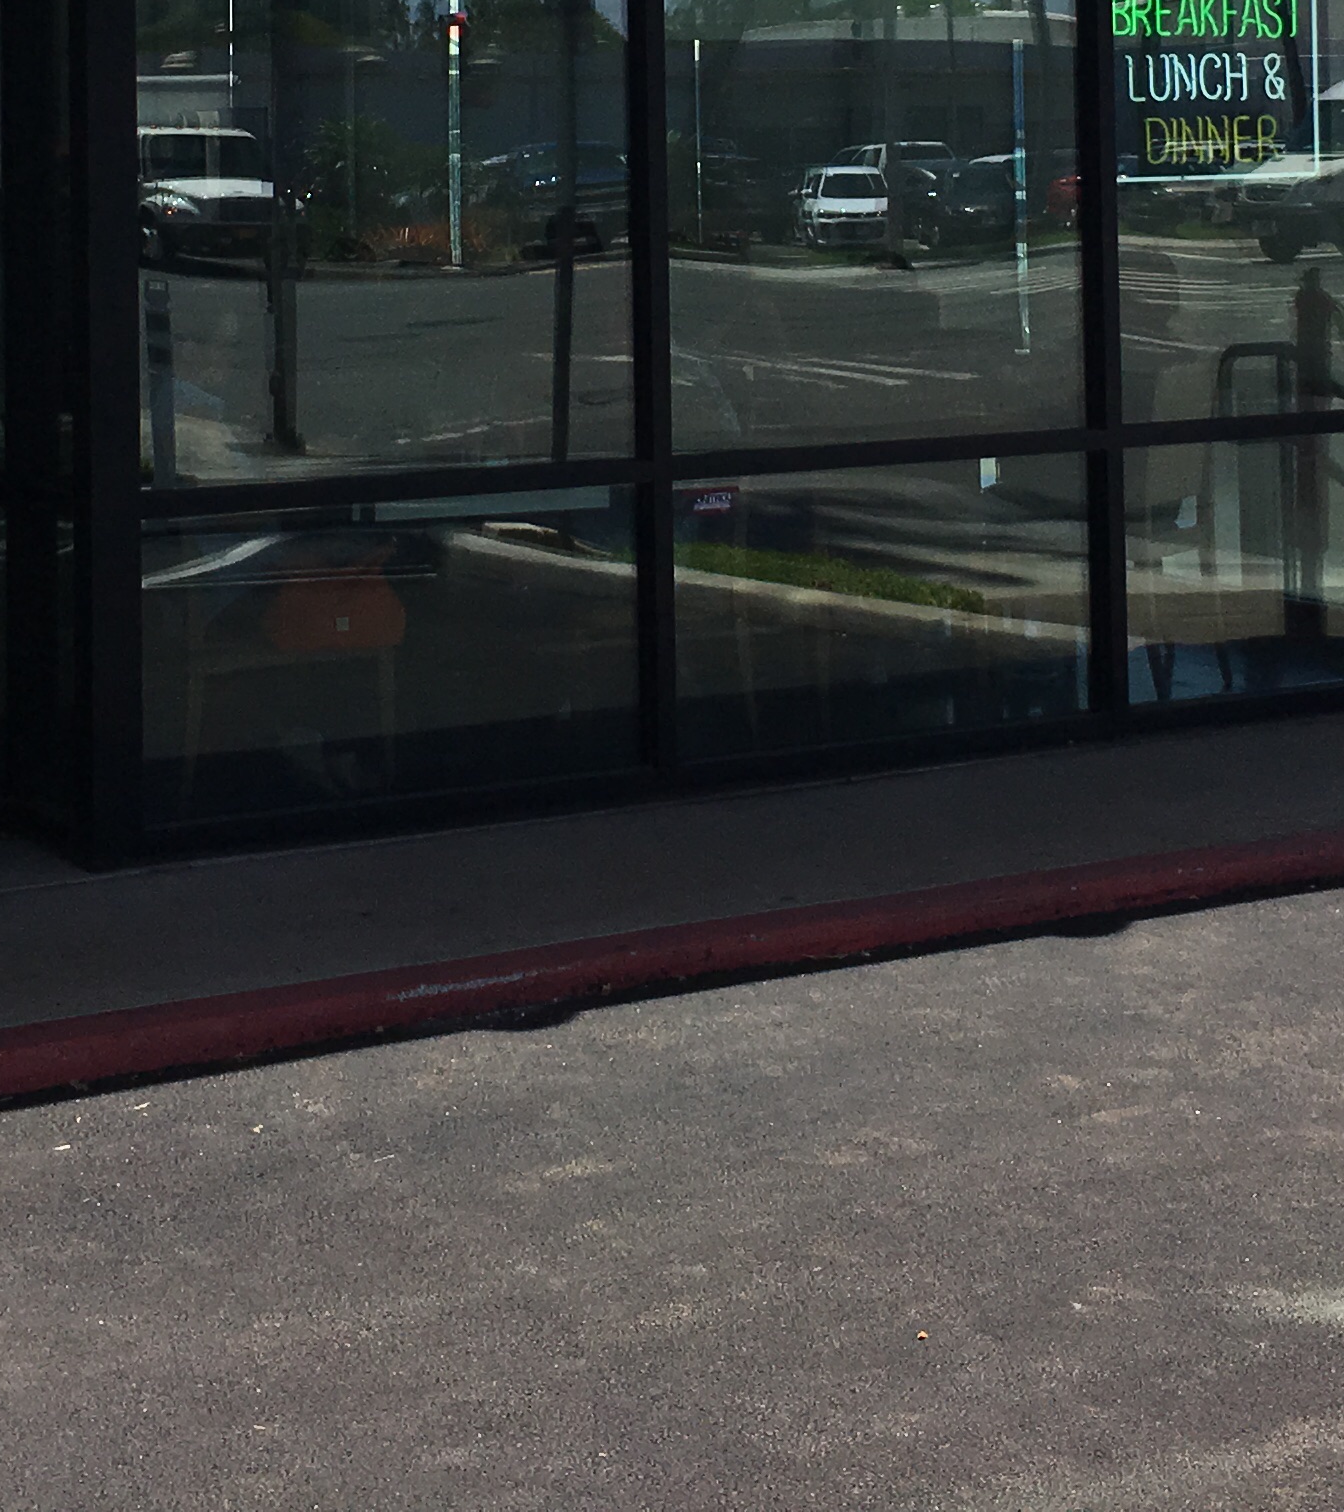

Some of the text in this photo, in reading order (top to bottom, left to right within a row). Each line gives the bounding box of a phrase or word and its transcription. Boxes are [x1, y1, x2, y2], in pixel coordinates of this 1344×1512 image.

[1125, 52, 1286, 102] LUNCH &
[1144, 115, 1280, 165] DINNER
